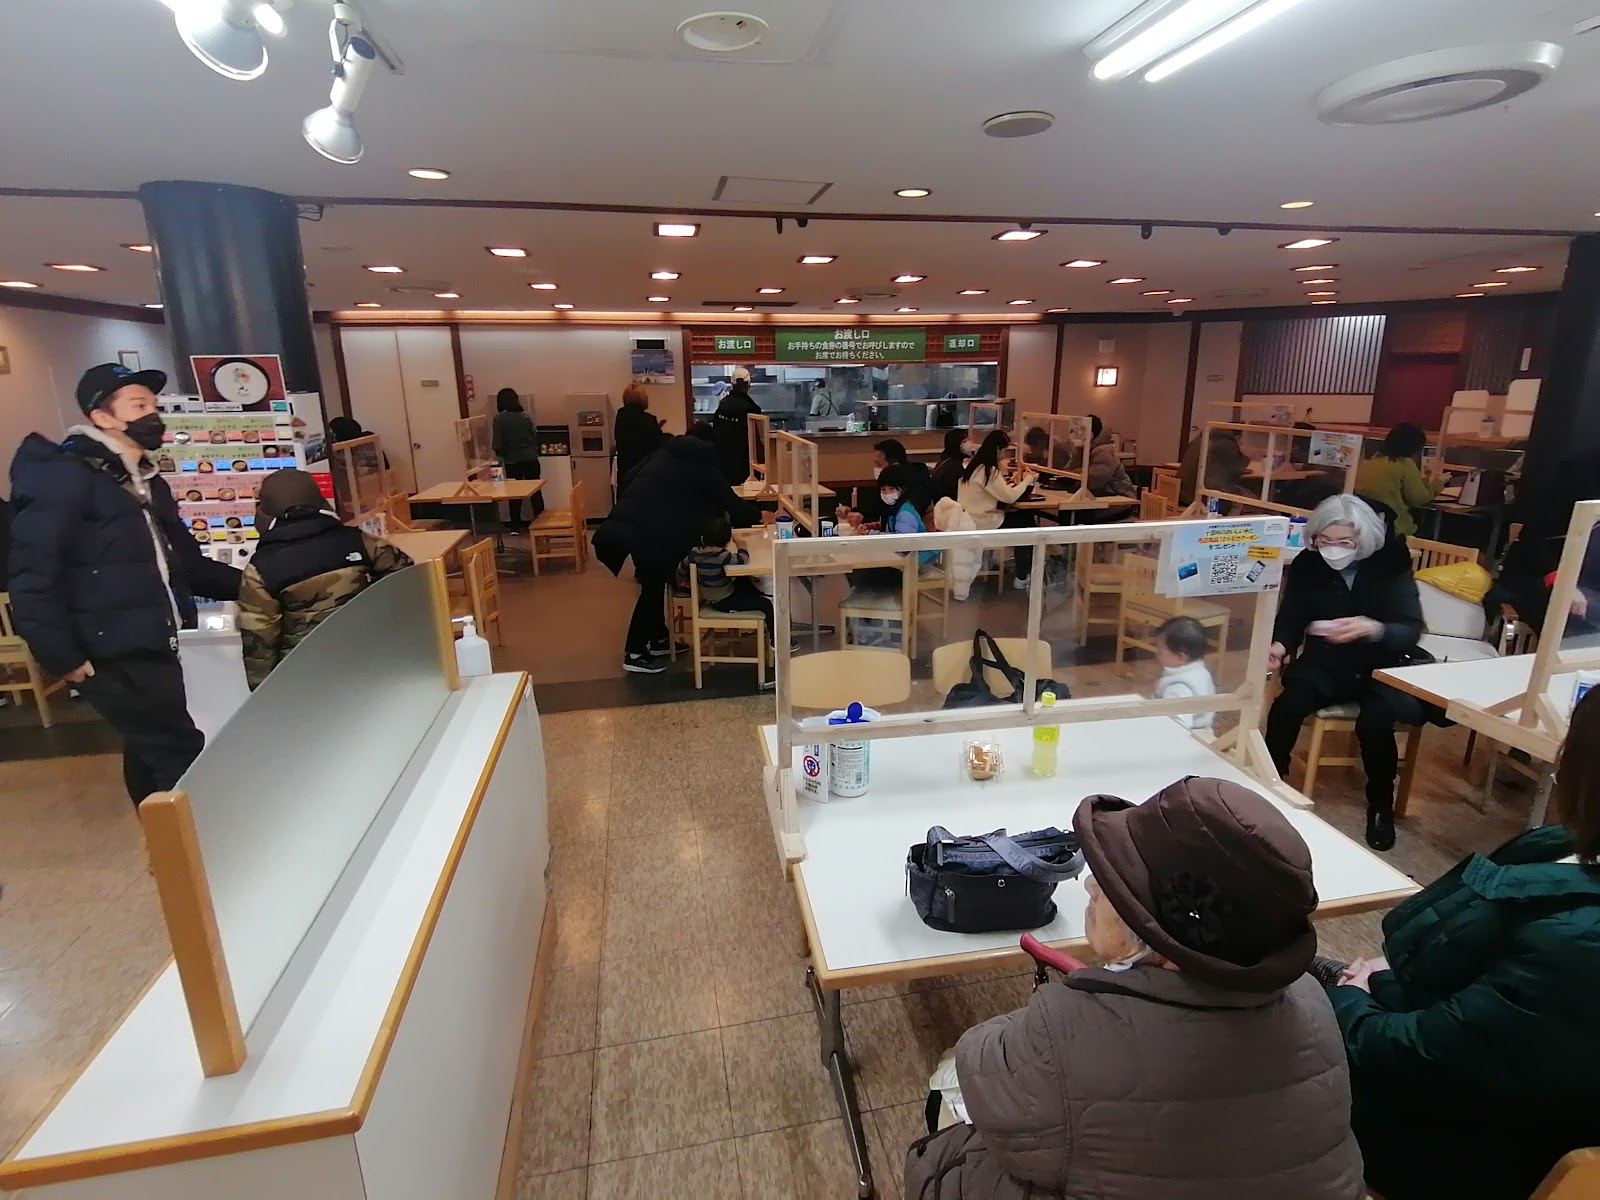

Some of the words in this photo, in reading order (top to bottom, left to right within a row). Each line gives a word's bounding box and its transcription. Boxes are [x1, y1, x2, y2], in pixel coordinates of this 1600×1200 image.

[834, 329, 870, 340] お渡し口
[718, 339, 752, 350] お渡し口
[787, 341, 915, 351] お手持ちの食券の番号でお呼びしますので
[948, 339, 975, 349] 返却口
[815, 351, 885, 360] お席でお待ちください。
